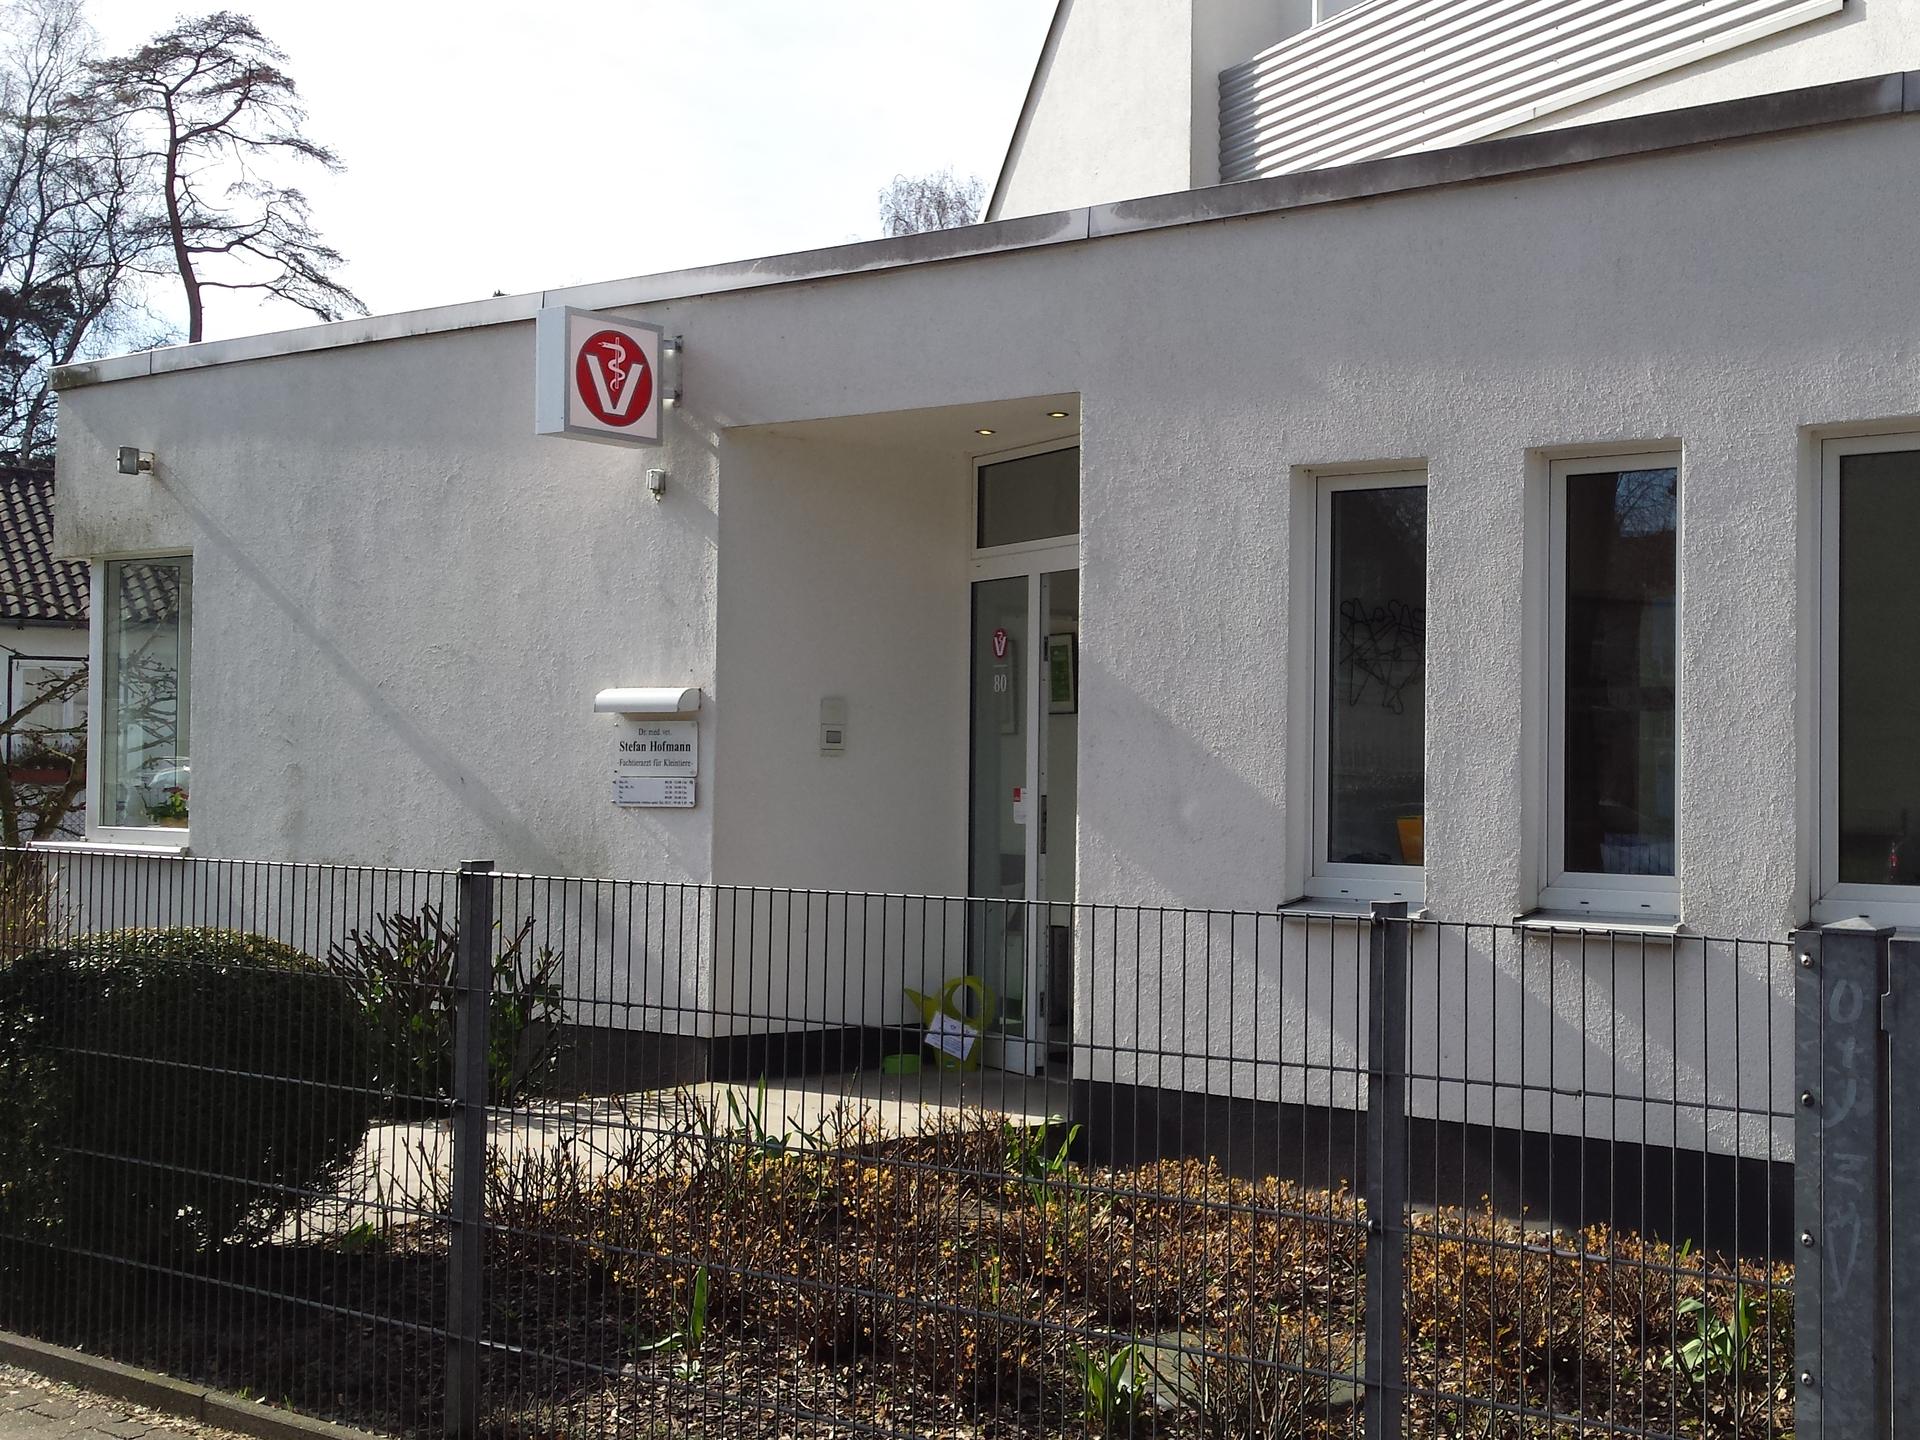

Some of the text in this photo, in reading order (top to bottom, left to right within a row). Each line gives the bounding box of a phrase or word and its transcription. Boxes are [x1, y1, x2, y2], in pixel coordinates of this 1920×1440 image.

[993, 674, 1007, 693] 80
[638, 728, 672, 736] Dr. med. vet.
[619, 741, 691, 752] Stefan Hofmann
[653, 759, 662, 767] für
